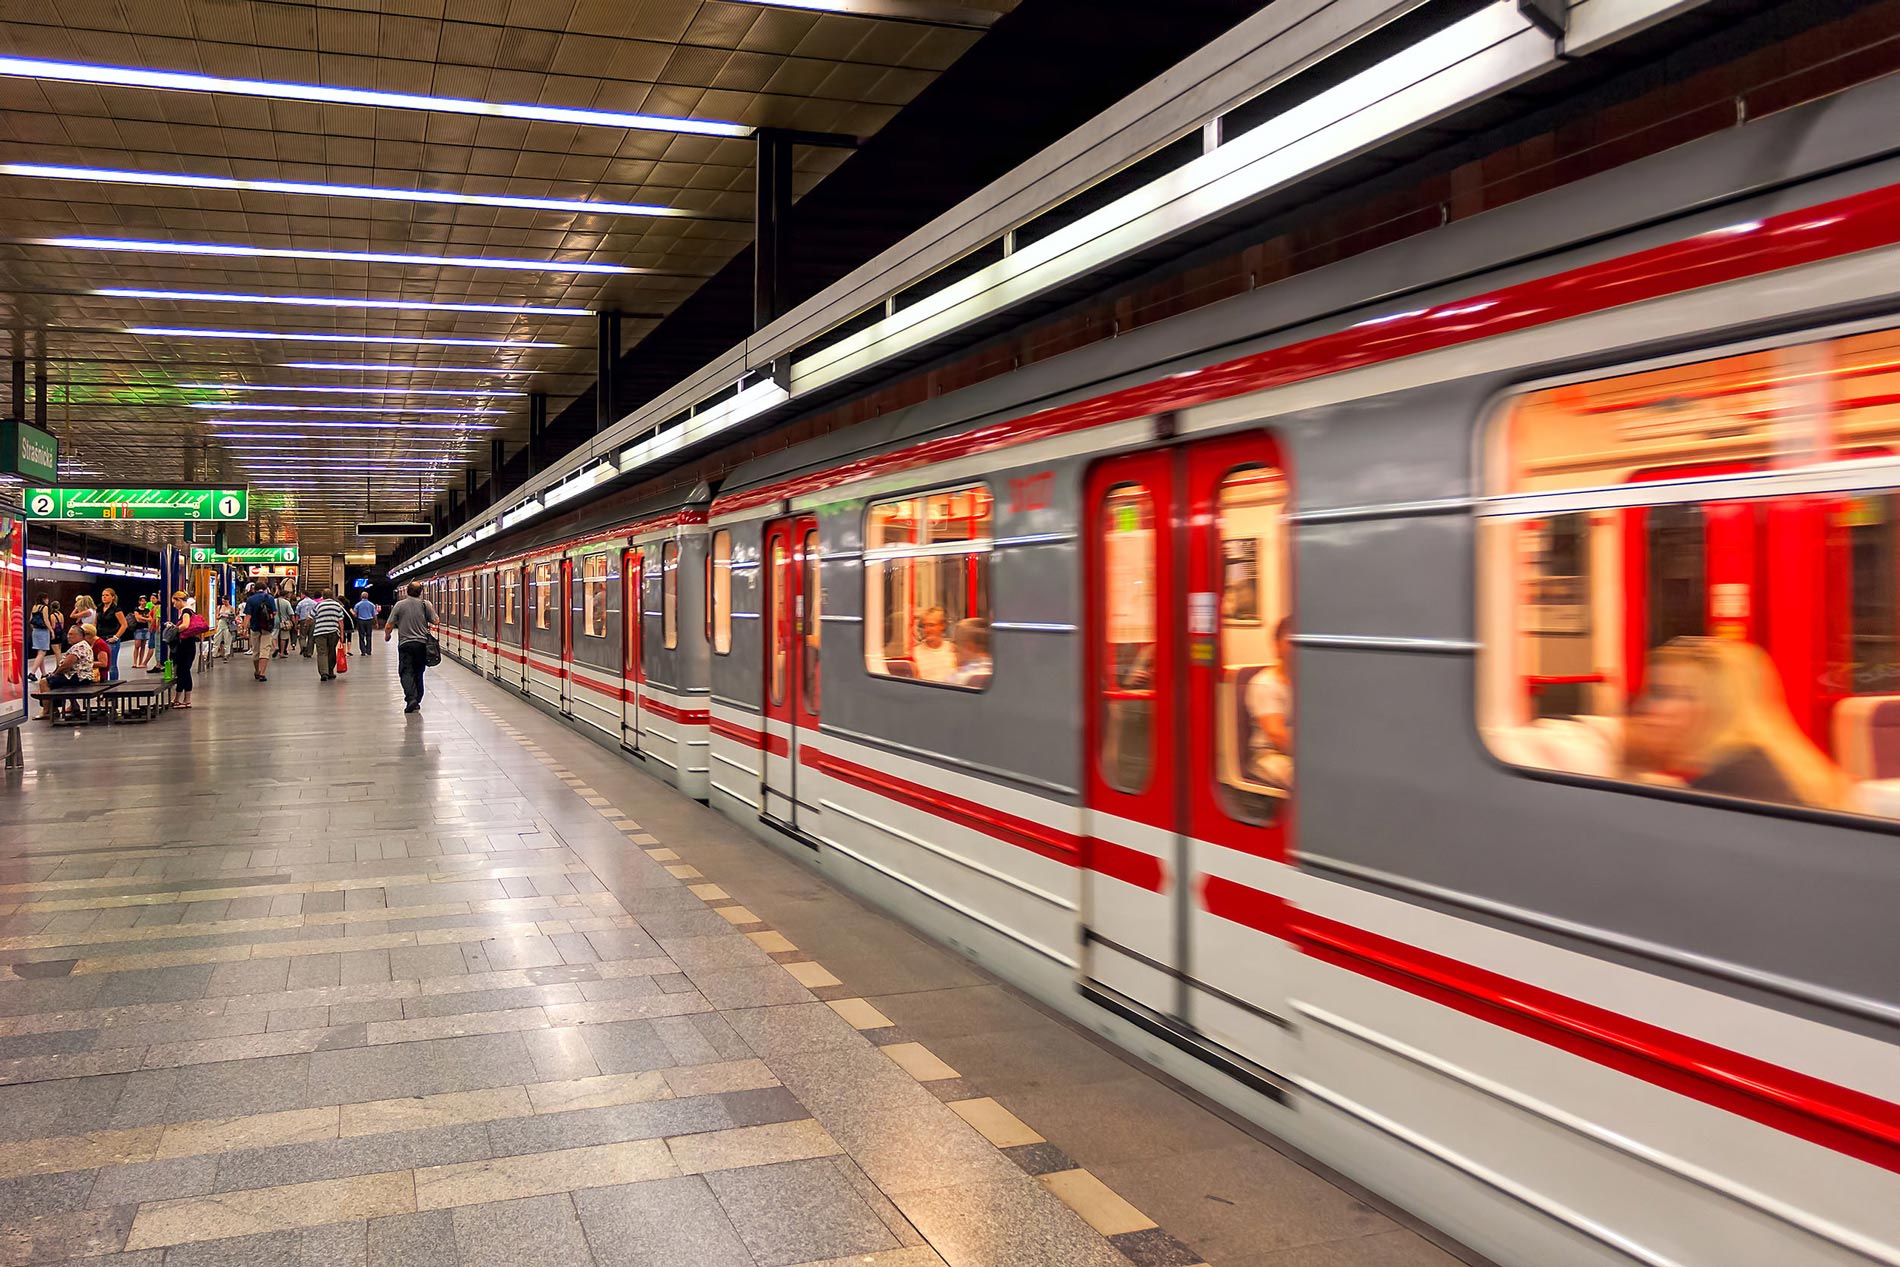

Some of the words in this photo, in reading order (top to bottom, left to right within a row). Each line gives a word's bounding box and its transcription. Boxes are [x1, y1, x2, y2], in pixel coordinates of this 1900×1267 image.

[22, 437, 53, 469] Strašnická
[37, 498, 49, 513] 2
[225, 499, 232, 513] 1
[103, 509, 110, 518] B
[127, 509, 135, 518] C
